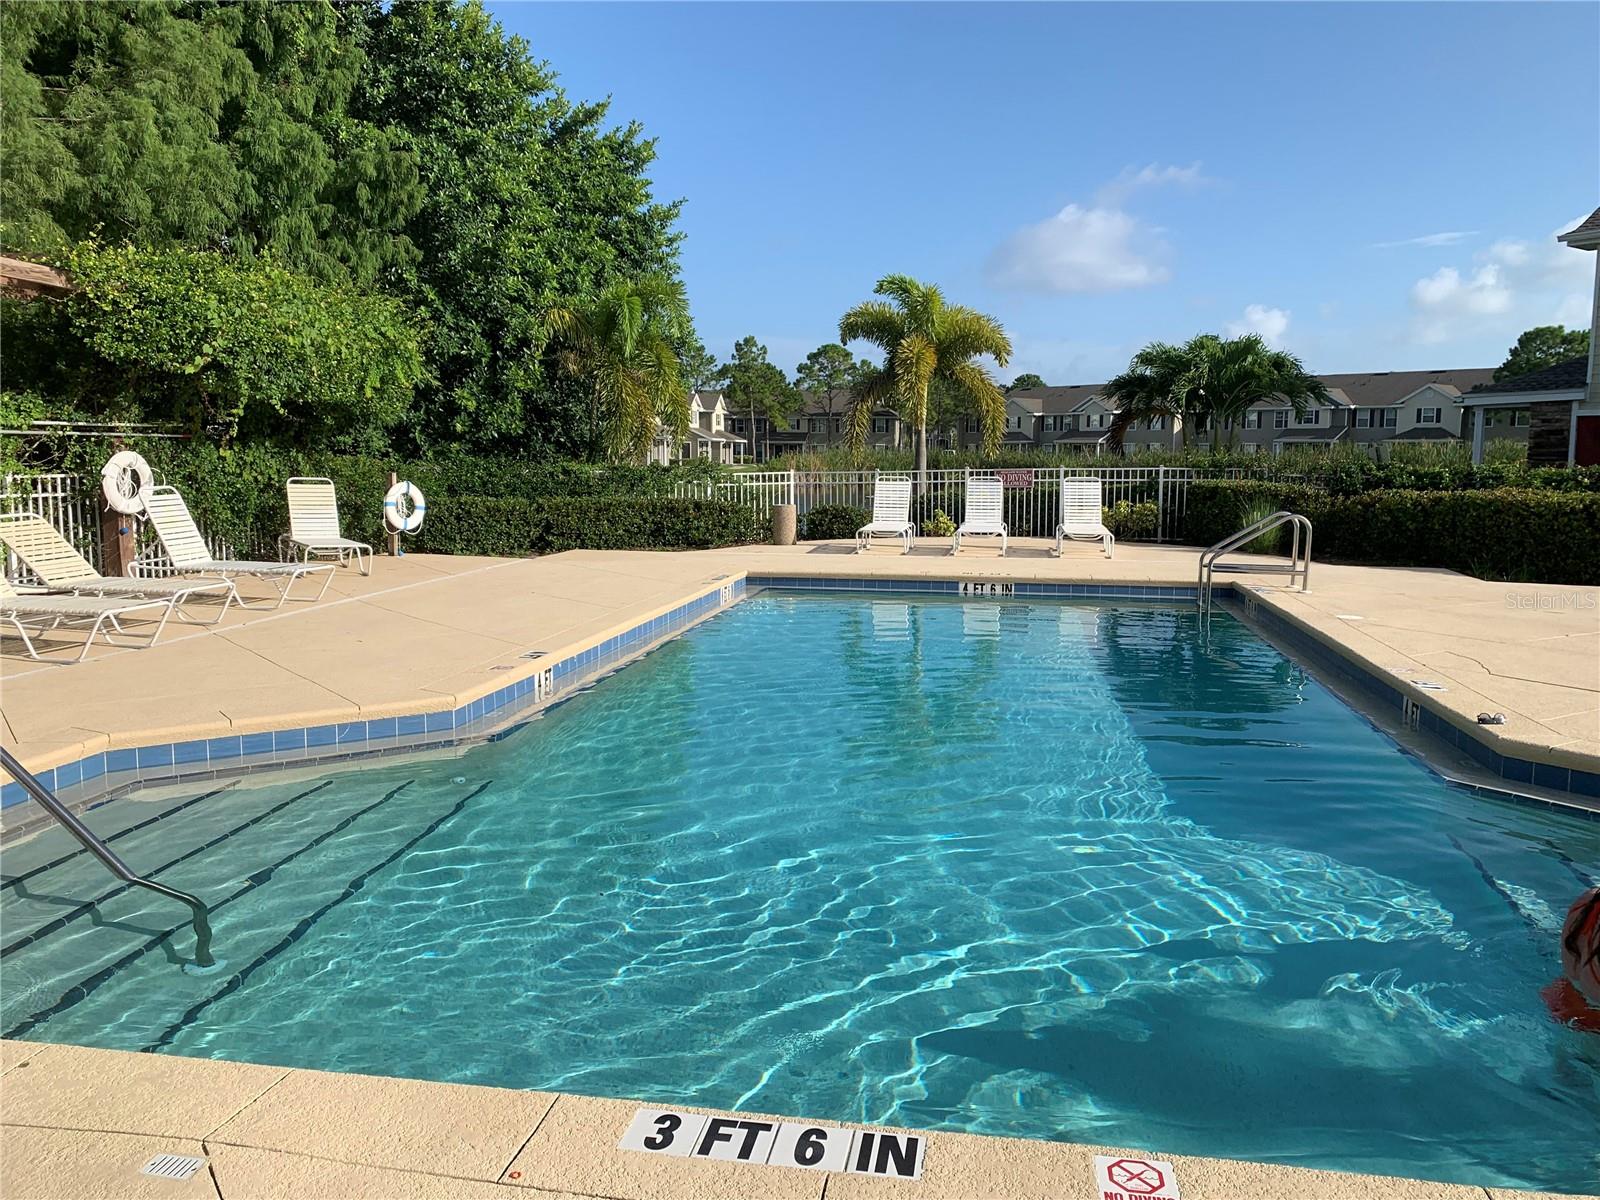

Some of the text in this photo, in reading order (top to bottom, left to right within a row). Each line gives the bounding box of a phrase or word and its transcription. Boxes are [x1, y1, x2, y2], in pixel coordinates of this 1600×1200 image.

[1007, 473, 1032, 482] DIVING
[963, 583, 969, 592] 4
[974, 583, 985, 593] FT
[1002, 583, 1013, 593] IN
[643, 1113, 919, 1177] 3 FT 6 IN
[1103, 1191, 1124, 1200] NO
